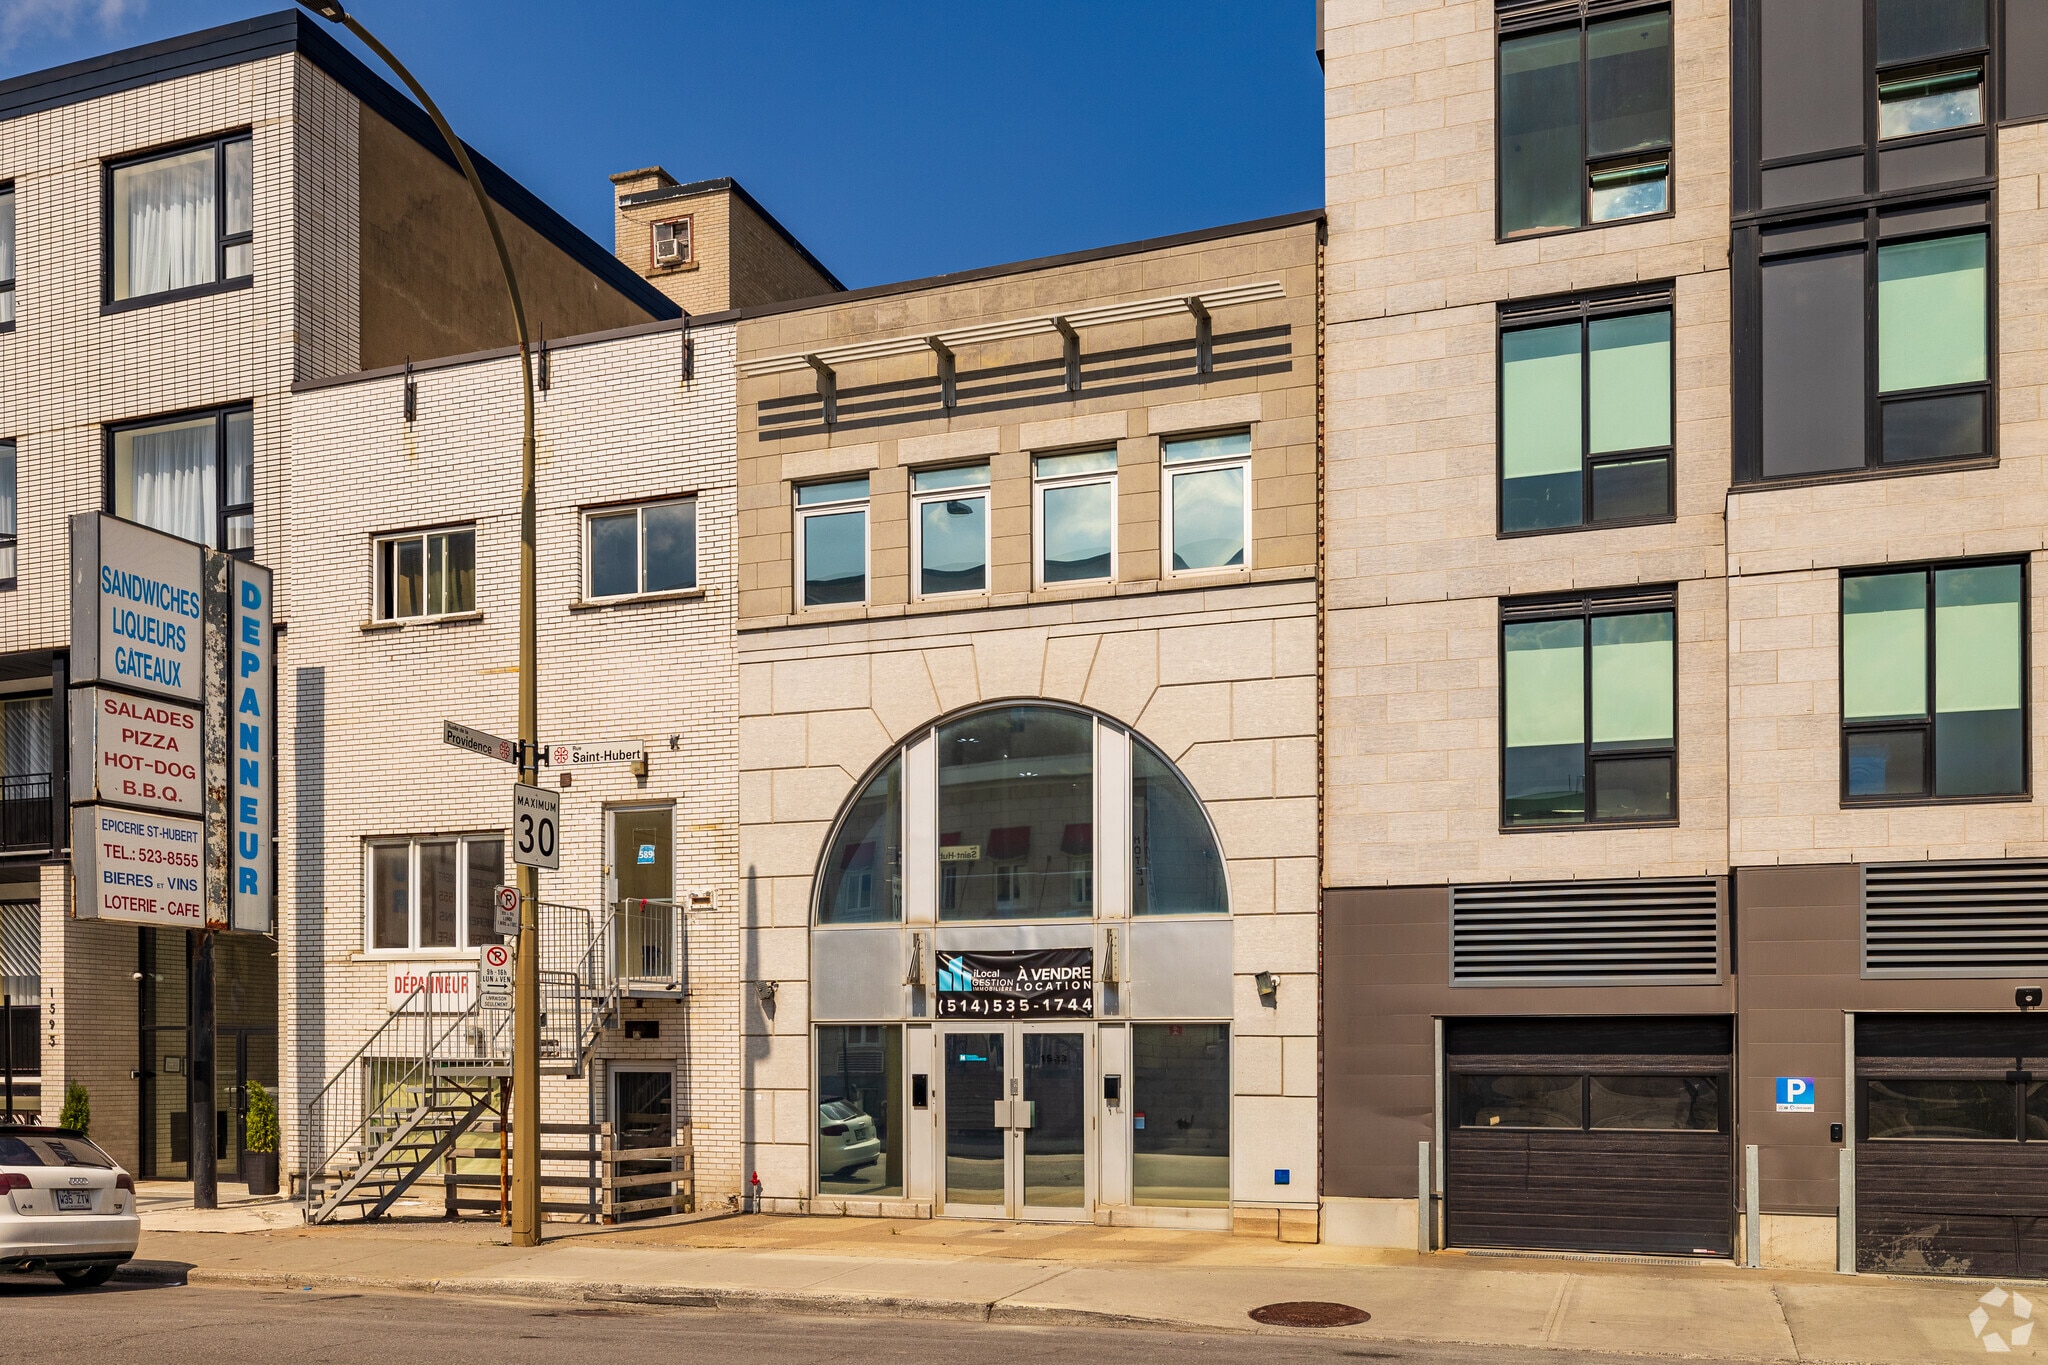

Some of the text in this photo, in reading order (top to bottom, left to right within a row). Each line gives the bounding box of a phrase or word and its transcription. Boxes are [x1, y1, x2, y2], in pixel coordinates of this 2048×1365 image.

[101, 565, 200, 619] SANDWICHES
[112, 607, 186, 652] LIQUEURS
[115, 647, 181, 688] GÂTEAUX
[104, 699, 194, 729] SALADES
[122, 728, 179, 752] PIZZA
[239, 580, 262, 895] DEPANNEUR
[447, 730, 492, 754] Providence
[104, 752, 196, 780] HOT-DOG
[572, 749, 641, 763] Saint-Hubert
[123, 780, 183, 802] B.B.Q.
[517, 795, 556, 812] MAXIMUM
[102, 818, 198, 844] EPICERIE ST-HUBERT
[518, 813, 555, 857] 30
[104, 844, 198, 867] TEL.: 523-8555
[639, 850, 653, 859] 589
[103, 870, 153, 888] BIERES
[167, 877, 198, 891] VINS
[104, 894, 157, 913] LOTERIE
[167, 901, 200, 918] CAFE
[972, 979, 1014, 987] GESTION
[973, 969, 1000, 978] iLocal
[1017, 965, 1091, 981] À VENDRE
[1016, 981, 1092, 991] LOCATION
[938, 998, 1093, 1015] (514)535-1744
[1787, 1079, 1806, 1102] P
